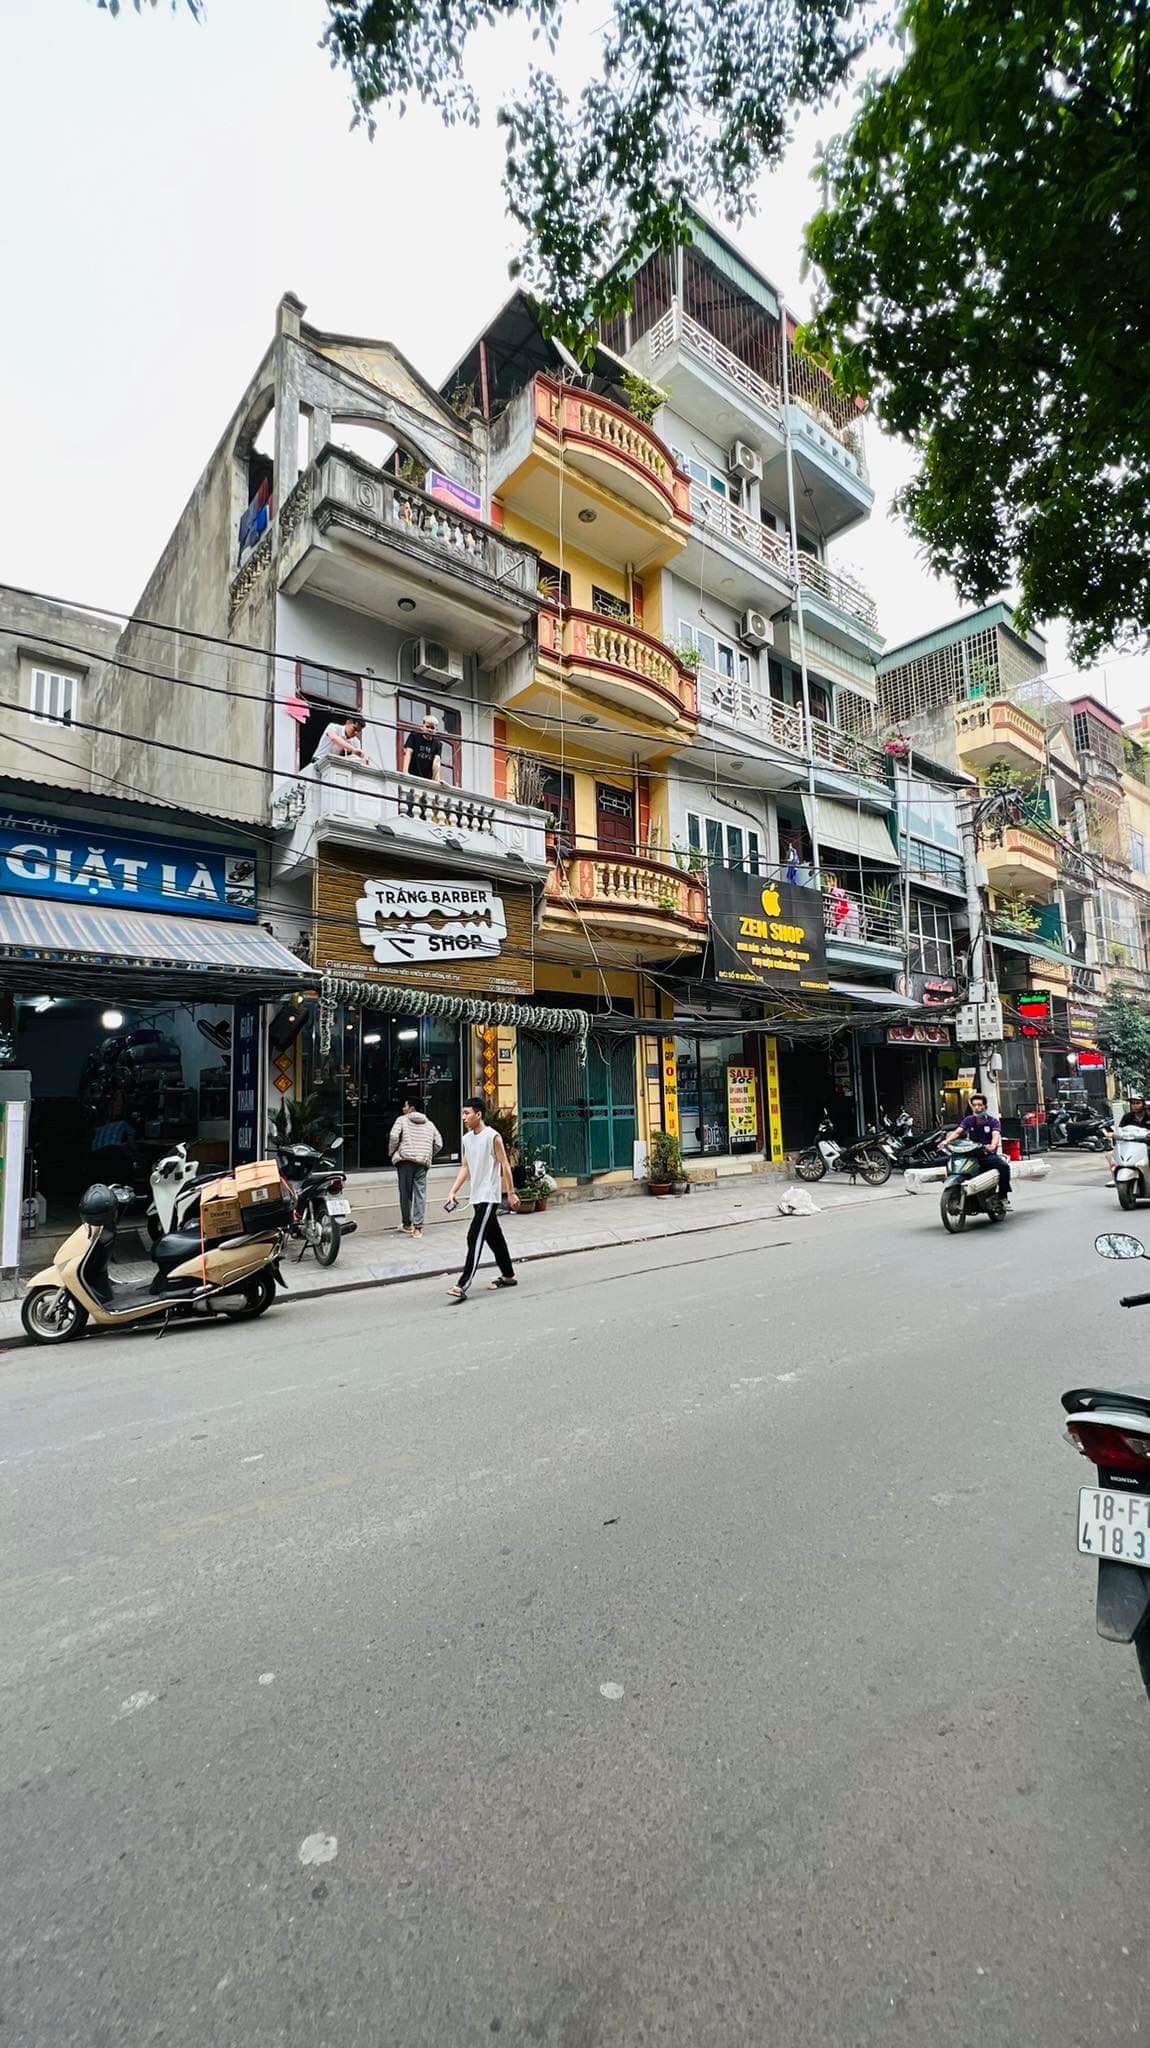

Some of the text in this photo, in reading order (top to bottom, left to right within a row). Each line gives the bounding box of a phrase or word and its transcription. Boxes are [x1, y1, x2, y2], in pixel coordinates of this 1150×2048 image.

[6, 844, 220, 901] GIẶT LÀ
[431, 891, 487, 903] BARBER
[739, 916, 805, 945] ZEN SHOP
[428, 934, 482, 951] SHOP
[729, 1069, 754, 1078] SALE
[1110, 1475, 1139, 1484] HONDA
[1093, 1494, 1150, 1528] 18-F1
